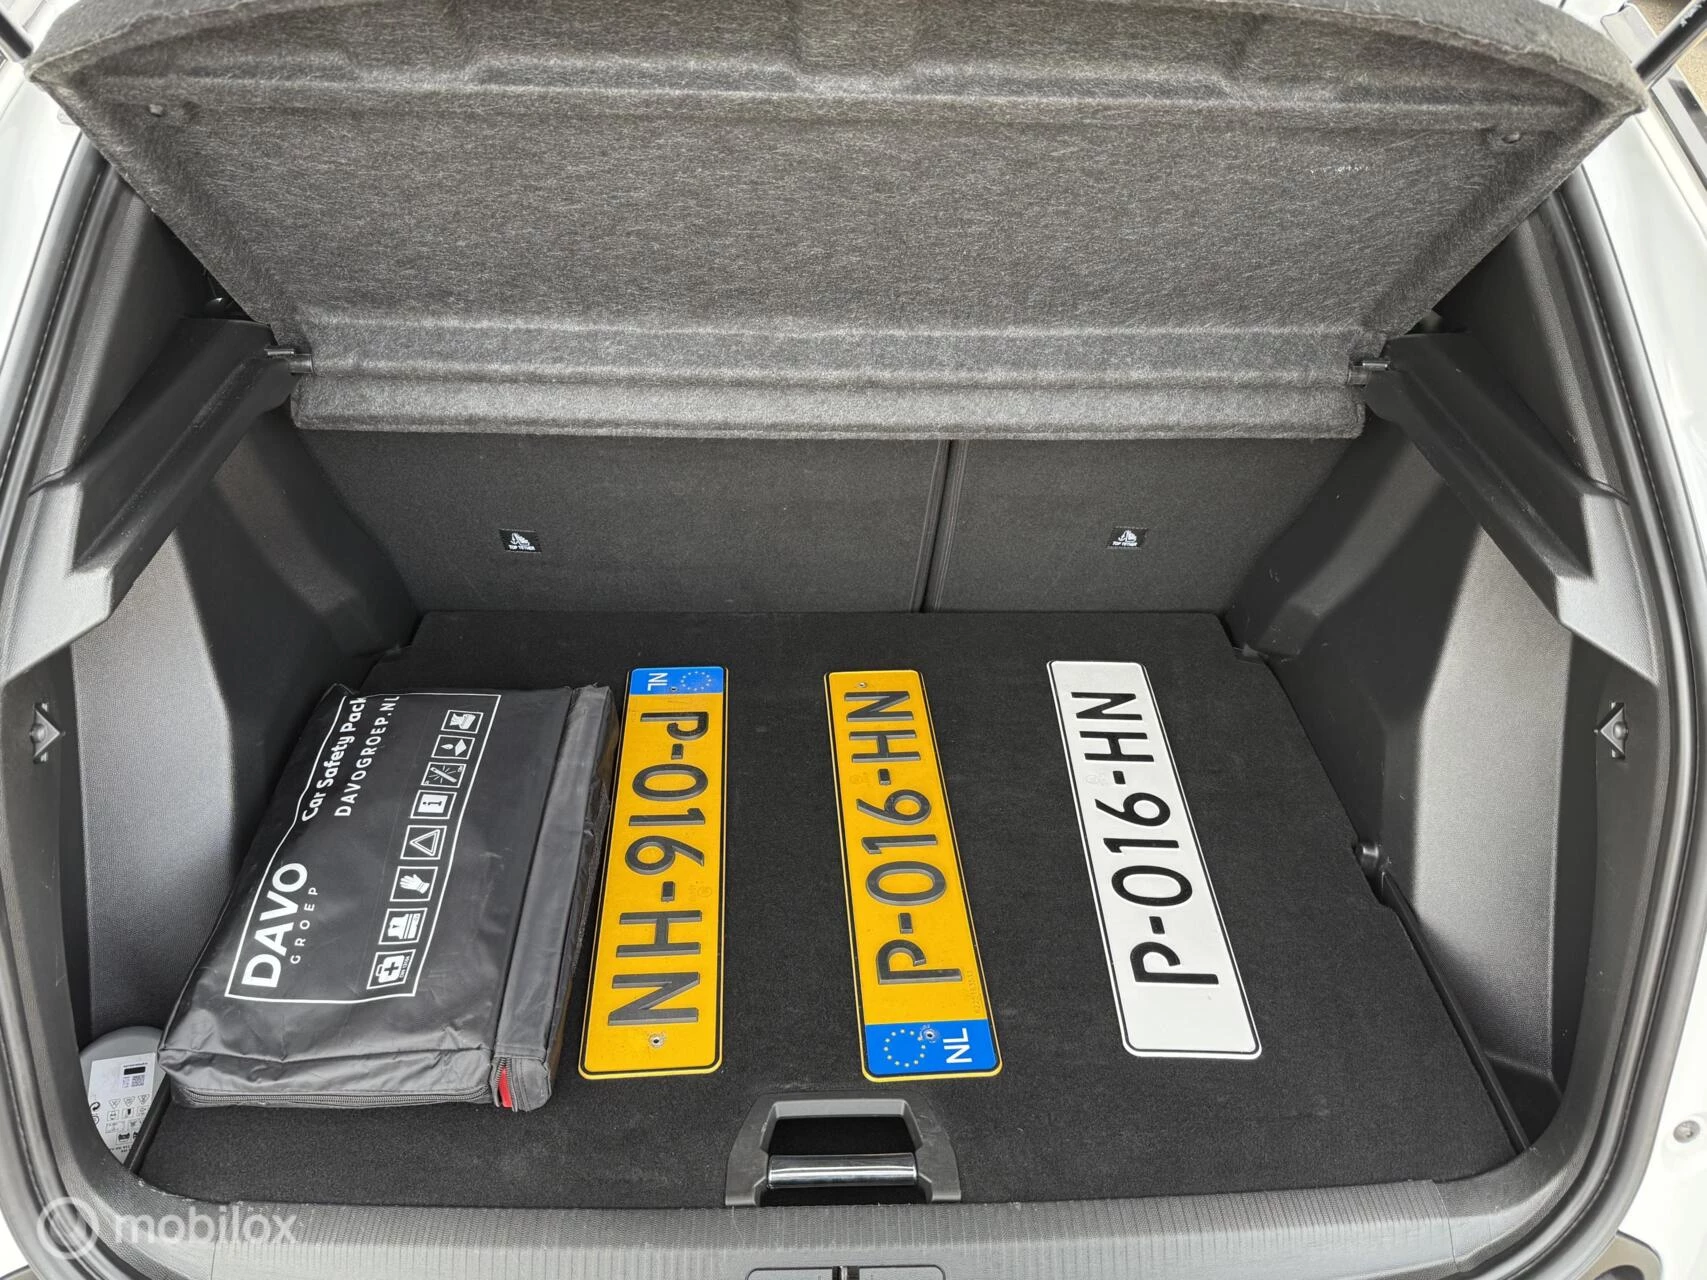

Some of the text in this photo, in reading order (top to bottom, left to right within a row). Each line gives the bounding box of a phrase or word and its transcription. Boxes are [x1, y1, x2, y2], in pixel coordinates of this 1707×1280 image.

[647, 672, 669, 691] NL
[301, 791, 327, 822] Car
[316, 735, 356, 789] Safety
[334, 696, 400, 816] DAVOGROEP.NL
[607, 711, 710, 1027] P-016-HN
[844, 690, 963, 986] P-016-HN
[1071, 691, 1219, 986] P-016-HN
[241, 862, 308, 987] DAVO
[290, 887, 319, 964] GROEP
[942, 1027, 973, 1064] NL
